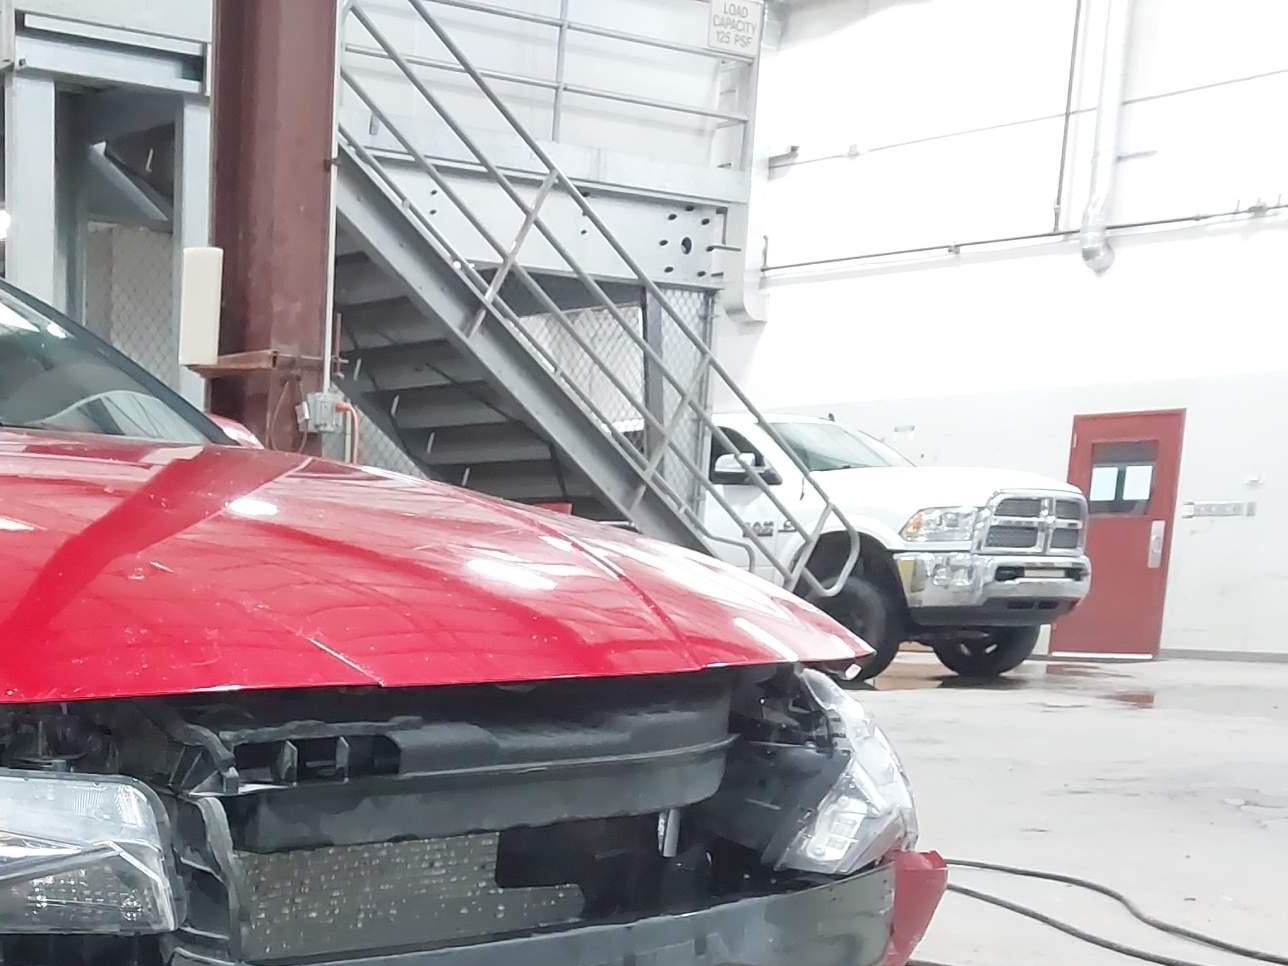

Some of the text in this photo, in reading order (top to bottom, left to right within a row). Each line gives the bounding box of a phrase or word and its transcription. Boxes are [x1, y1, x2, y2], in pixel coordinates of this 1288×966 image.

[723, 1, 749, 18] LOAD
[713, 14, 758, 33] CAPACITY
[716, 30, 730, 44] 125
